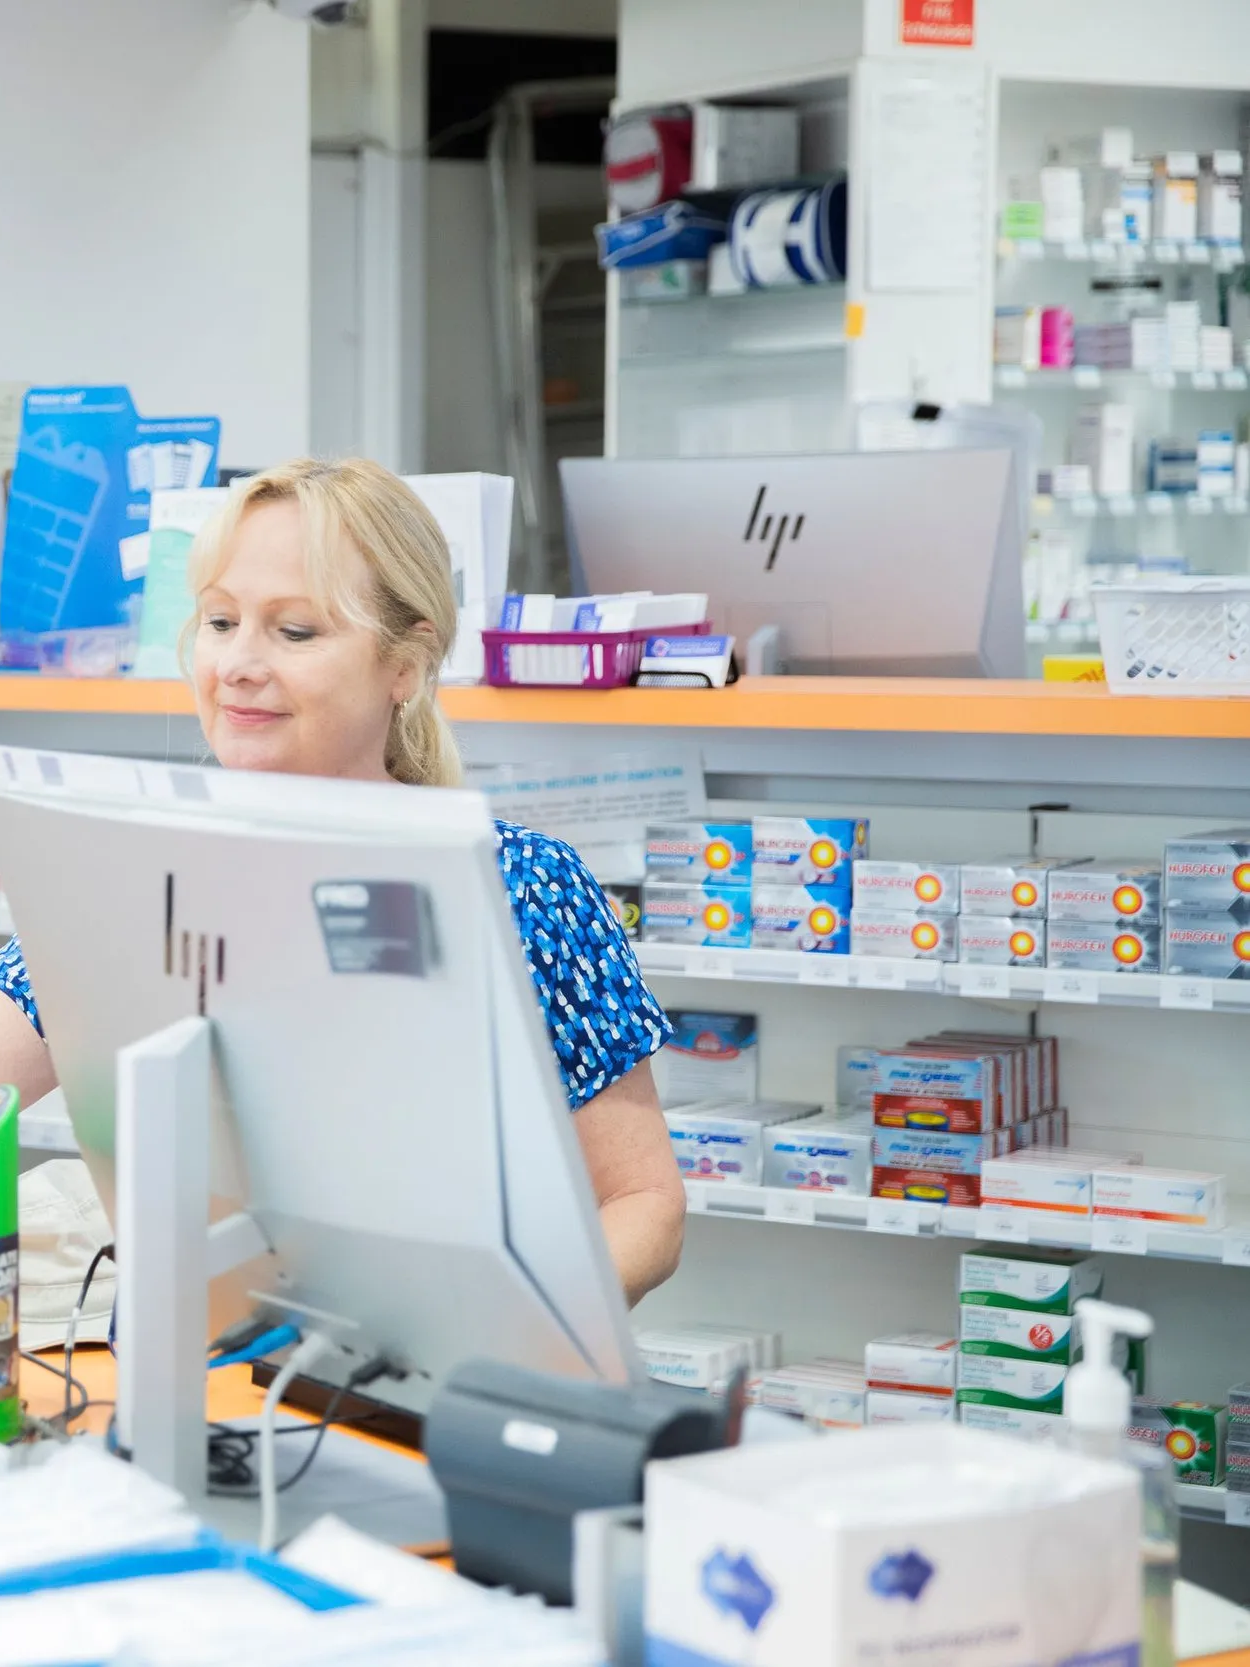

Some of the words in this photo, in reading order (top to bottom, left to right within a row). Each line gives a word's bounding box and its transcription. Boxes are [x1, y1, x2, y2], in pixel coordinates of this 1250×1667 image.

[1168, 864, 1226, 876] NUROFEN
[1051, 890, 1106, 901] NUROFEN
[1169, 930, 1226, 943] NUROFEN
[1051, 939, 1106, 951] NUROFEN
